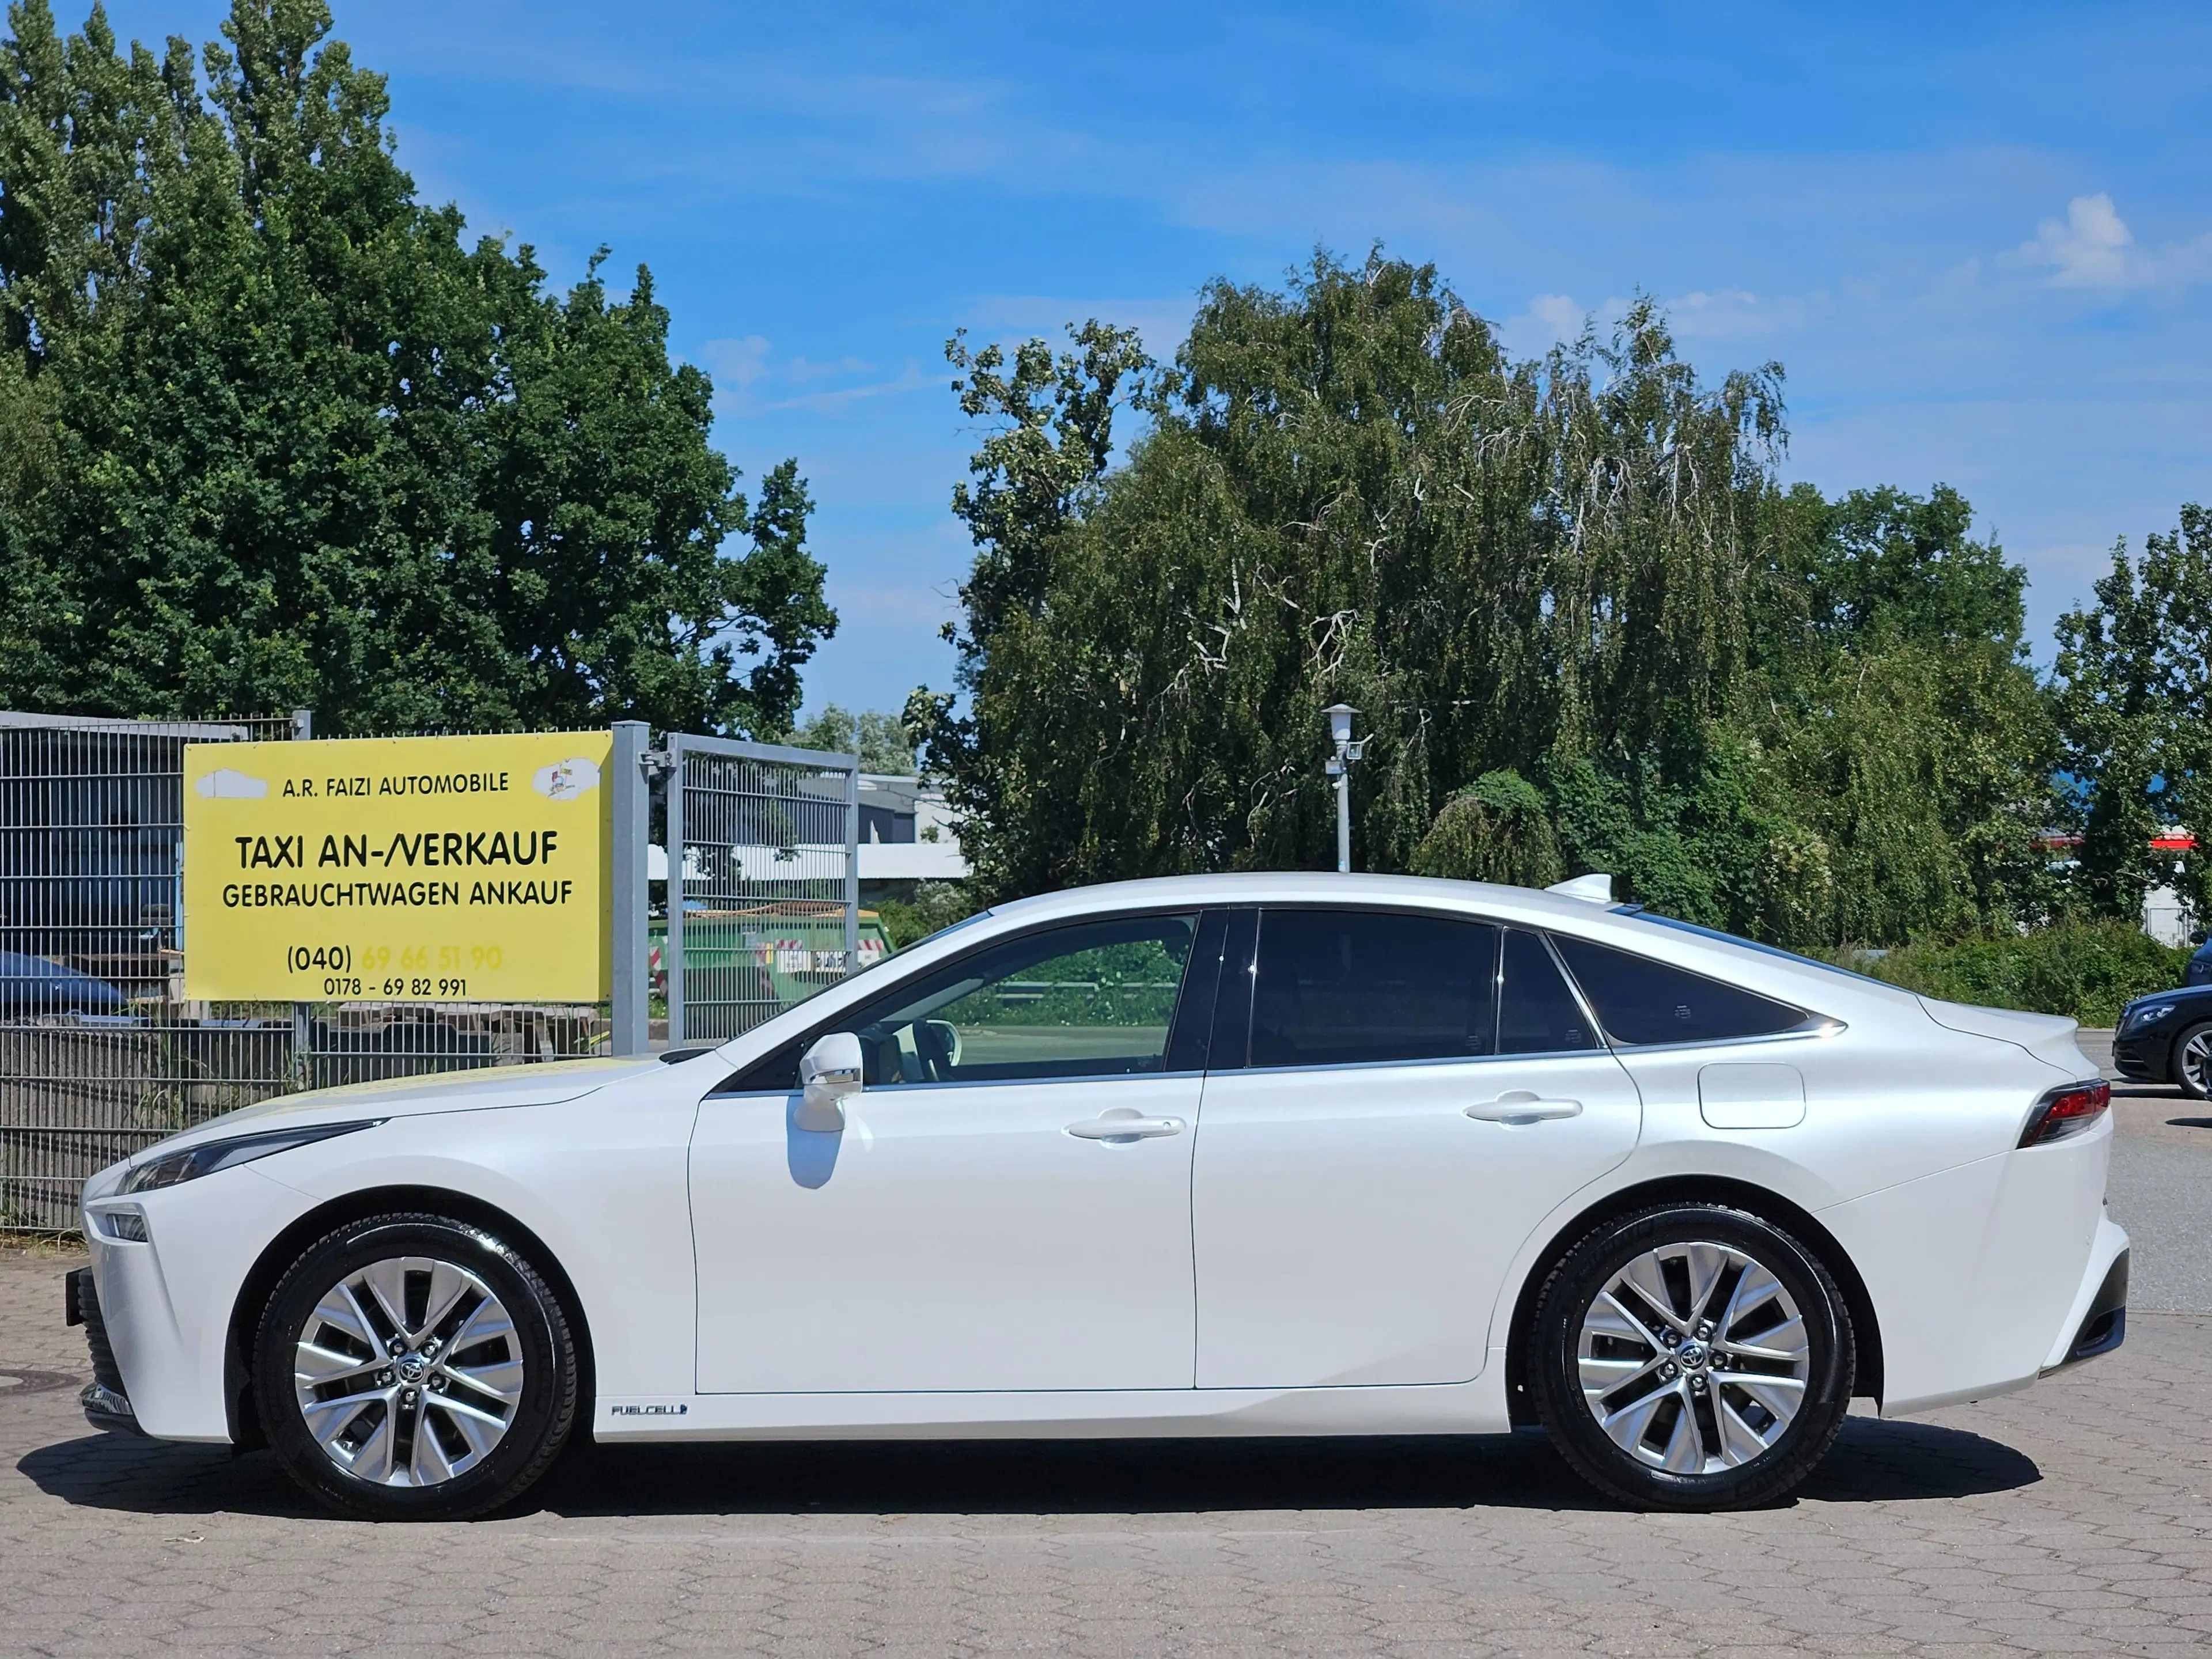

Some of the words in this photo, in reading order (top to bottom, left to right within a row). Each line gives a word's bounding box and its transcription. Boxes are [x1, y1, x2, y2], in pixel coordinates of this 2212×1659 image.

[282, 779, 318, 798] A.R.
[327, 777, 371, 797] FAIZI
[379, 772, 509, 796] AUTOMOBILE
[234, 835, 304, 869] TAXI
[223, 881, 459, 908] GEBRAUCHTWAGEN
[469, 880, 573, 906] ANKAUF
[287, 945, 351, 974] (040)
[362, 946, 391, 971] 69
[400, 945, 428, 971] 66
[438, 946, 460, 971] 51
[471, 945, 503, 971] 90
[324, 978, 362, 996] 0178
[383, 978, 404, 996] 69
[411, 978, 432, 996] 82
[438, 978, 467, 997] 991
